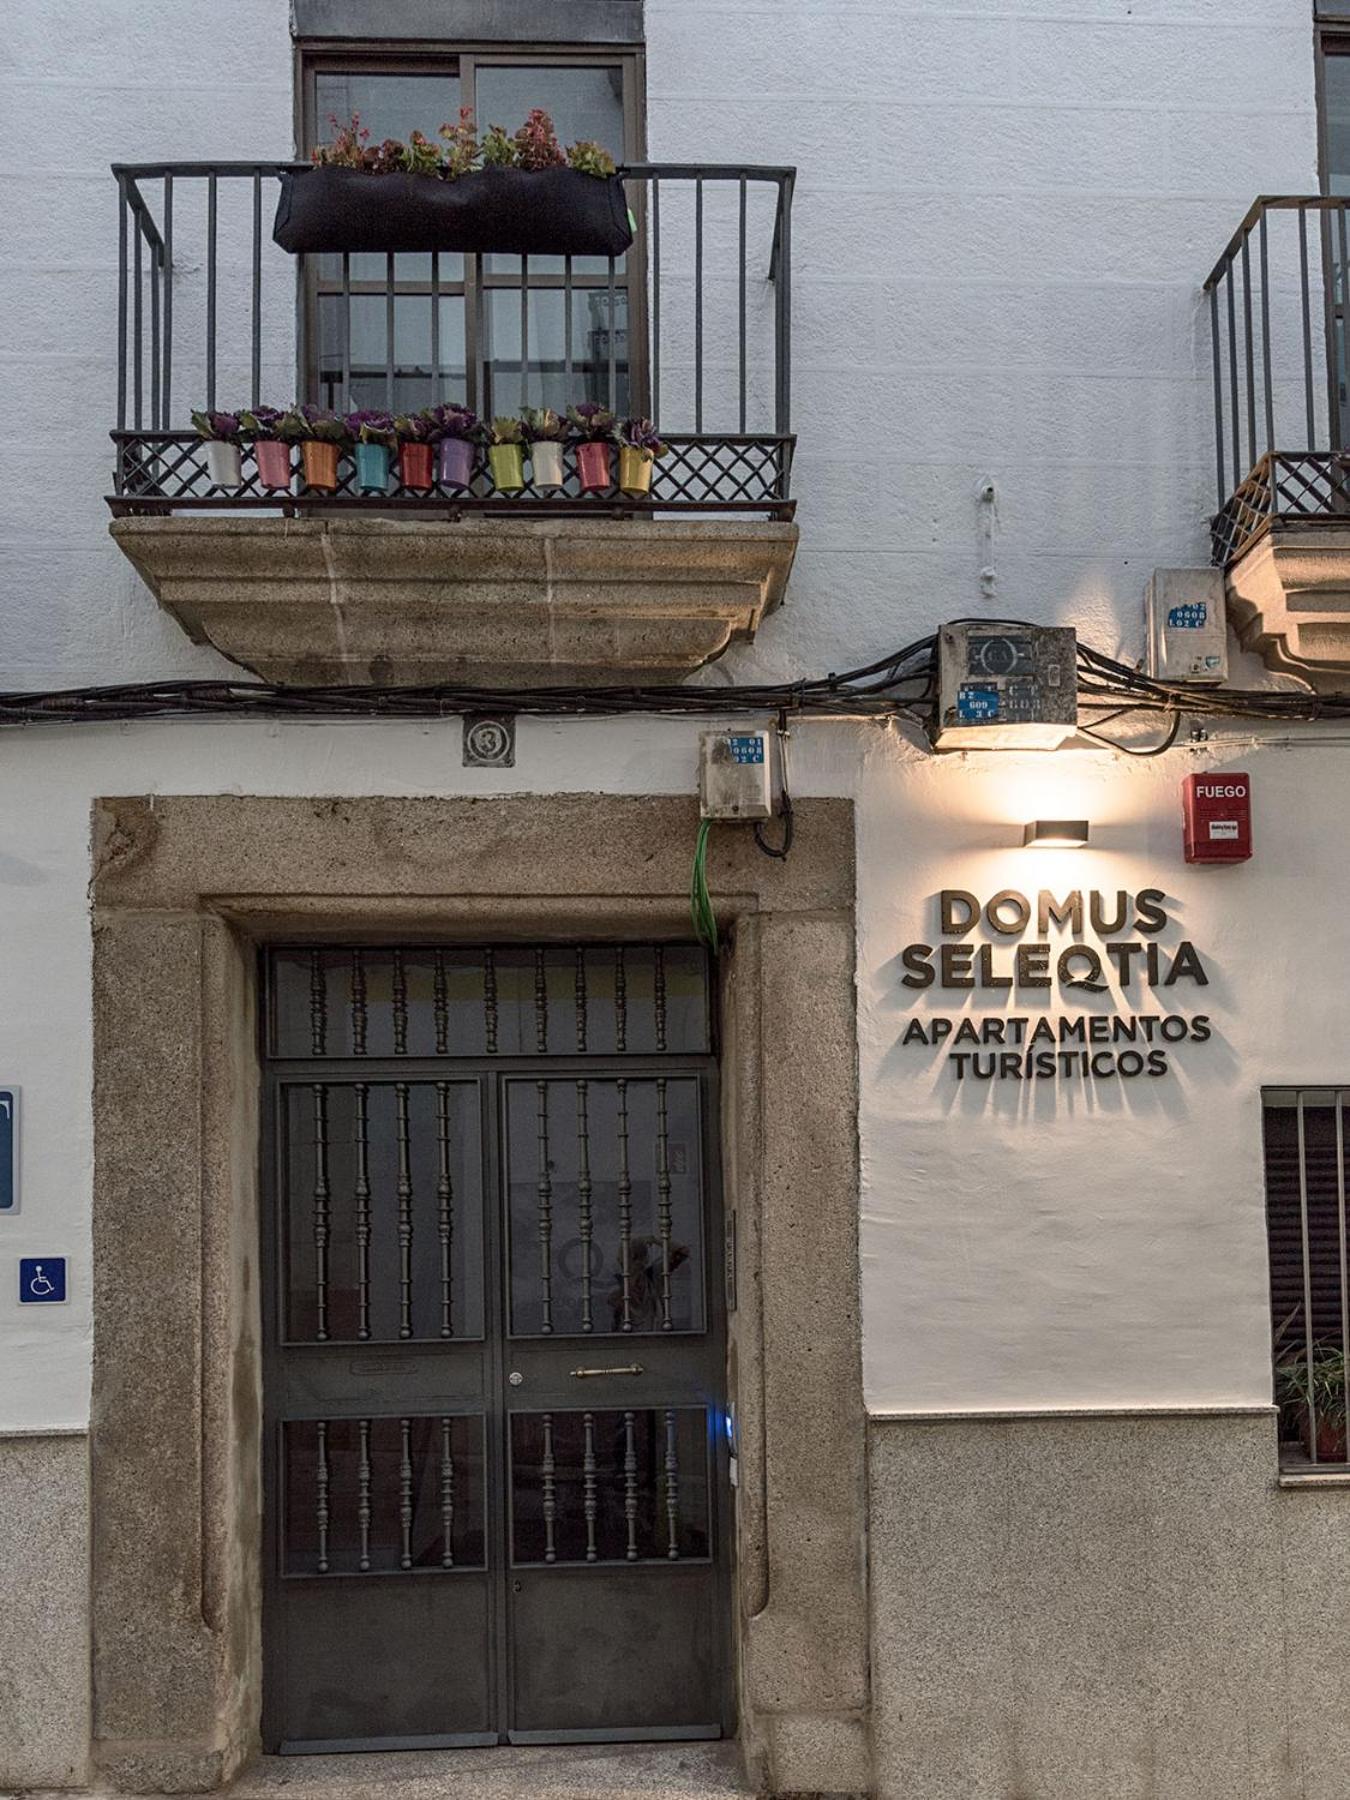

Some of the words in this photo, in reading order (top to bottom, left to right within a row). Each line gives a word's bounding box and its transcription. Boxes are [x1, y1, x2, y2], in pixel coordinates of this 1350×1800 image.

[1196, 785, 1246, 798] FUEGO
[940, 888, 1168, 935] DOMUS
[901, 941, 1209, 993] SELEQTIA
[902, 1014, 1211, 1046] APARTAMENTOS
[948, 1039, 1169, 1079] TURÍSTICOS
